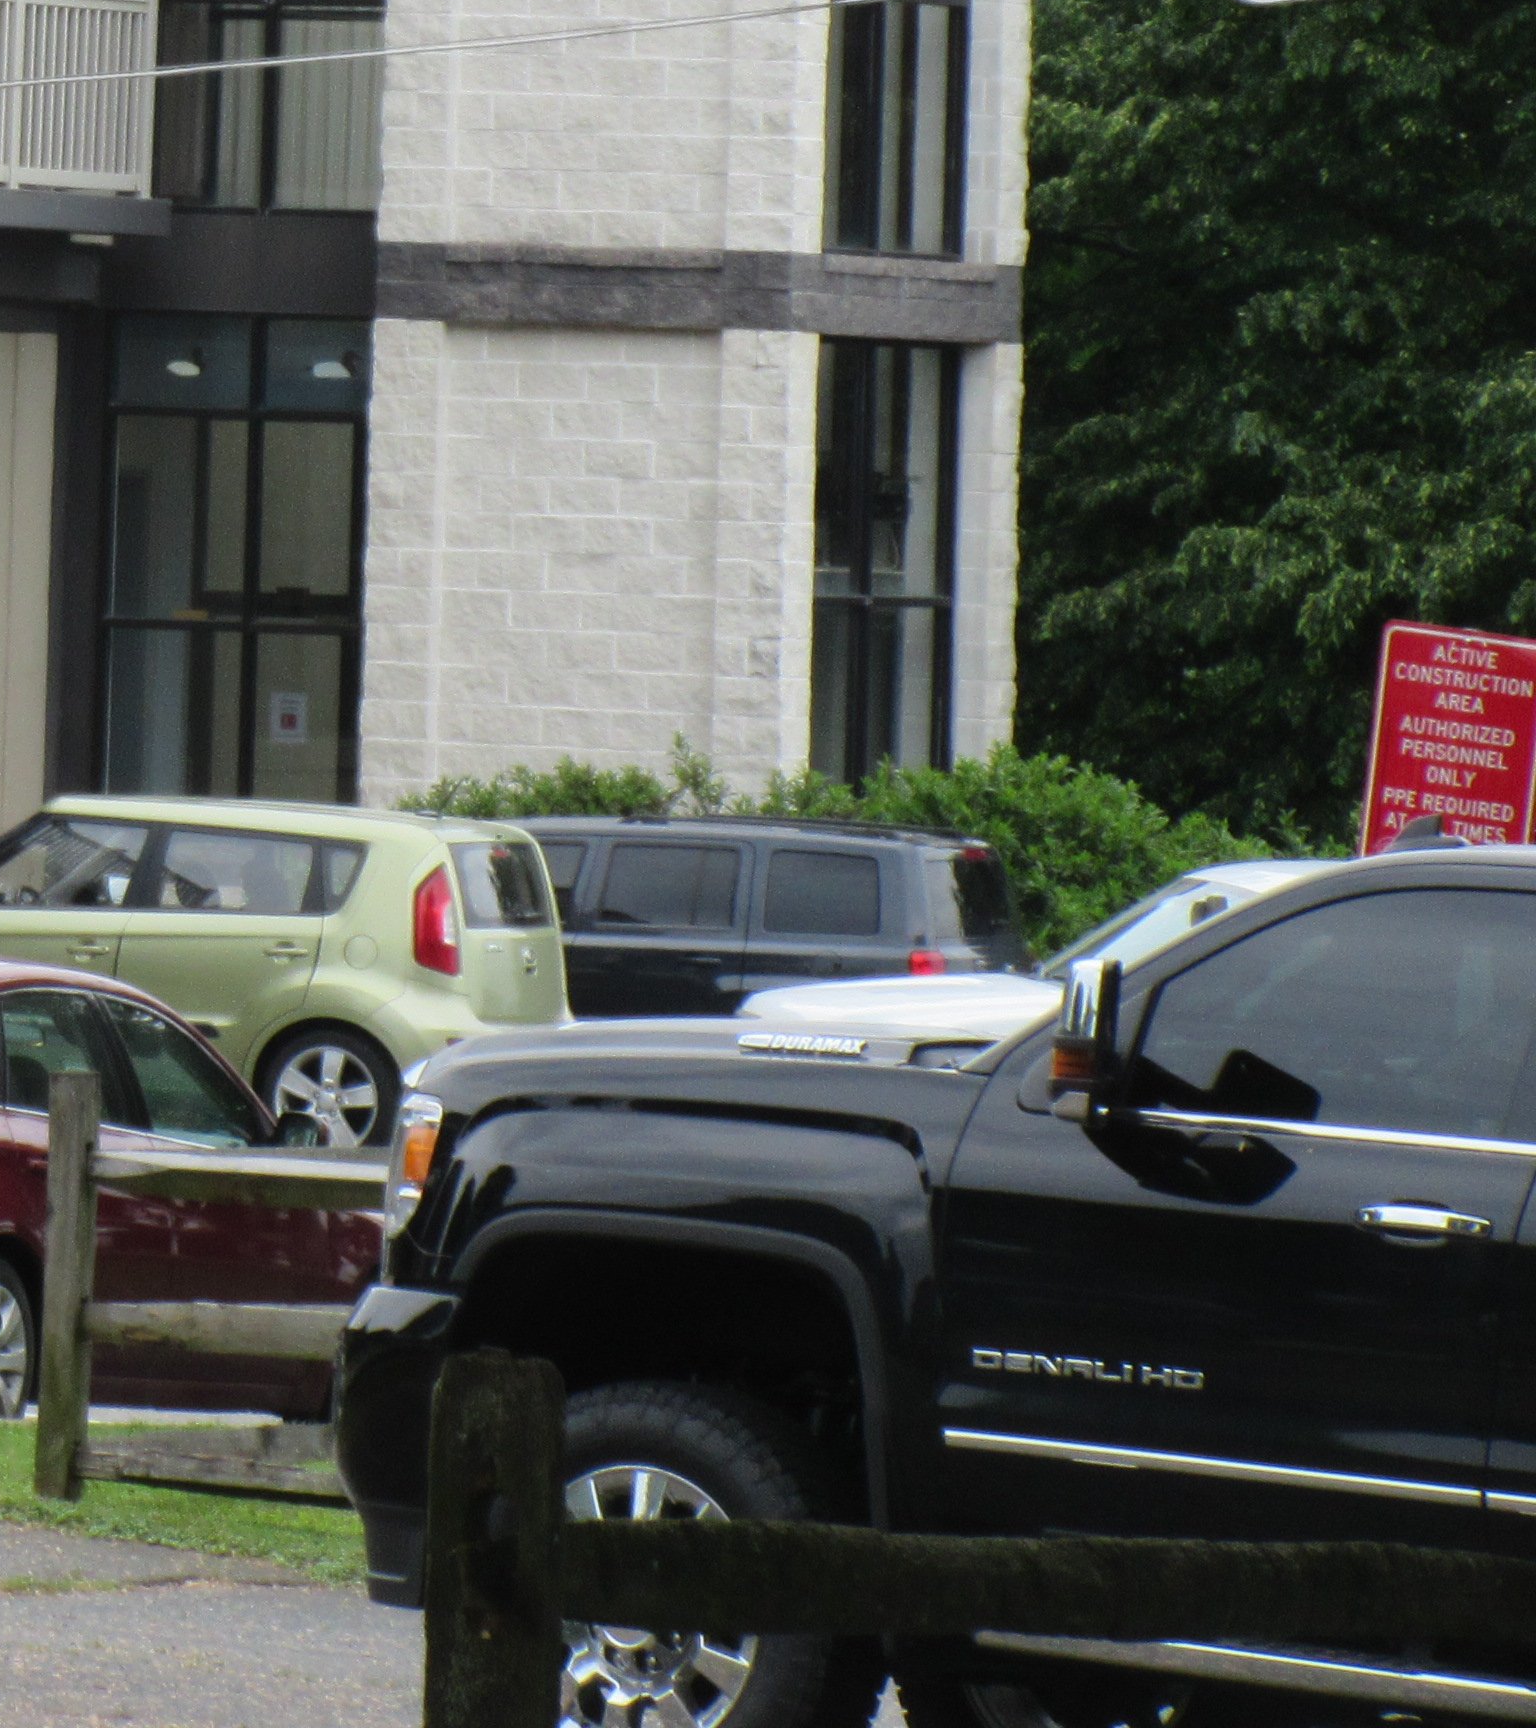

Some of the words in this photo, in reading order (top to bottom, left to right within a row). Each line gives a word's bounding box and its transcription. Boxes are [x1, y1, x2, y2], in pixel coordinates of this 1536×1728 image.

[1433, 644, 1499, 670] ACTIVE
[1394, 662, 1534, 698] CONSTRUCTION
[1435, 692, 1485, 714] AREA
[1400, 715, 1516, 748] AUTHORIZED
[1401, 738, 1509, 770] PERSONNEL
[1426, 766, 1477, 788] ONLY
[1383, 787, 1417, 809] PPE
[1422, 793, 1515, 823] REQUIRED
[1453, 820, 1507, 844] TIMES
[770, 1033, 867, 1055] DURAMAX
[972, 1347, 1132, 1384] DENALI
[1141, 1364, 1205, 1390] HD
